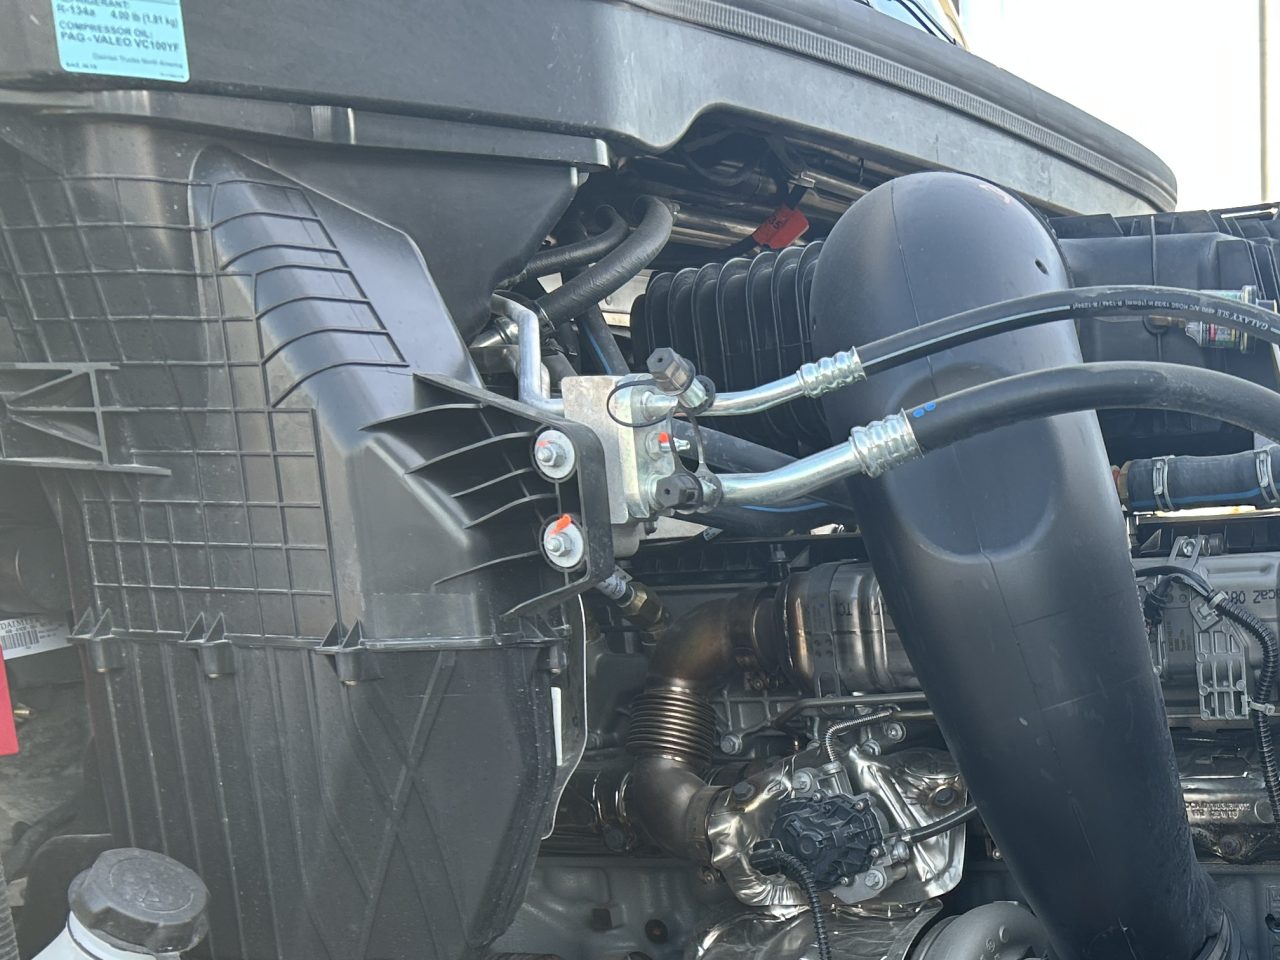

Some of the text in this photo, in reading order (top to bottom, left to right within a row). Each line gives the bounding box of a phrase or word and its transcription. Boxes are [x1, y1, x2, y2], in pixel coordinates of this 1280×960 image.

[57, 3, 96, 17] R-134a
[59, 20, 131, 36] COMPRESSOR
[93, 34, 132, 47] VALEO
[1217, 307, 1230, 319] SLE
[1230, 312, 1269, 331] GALAXY
